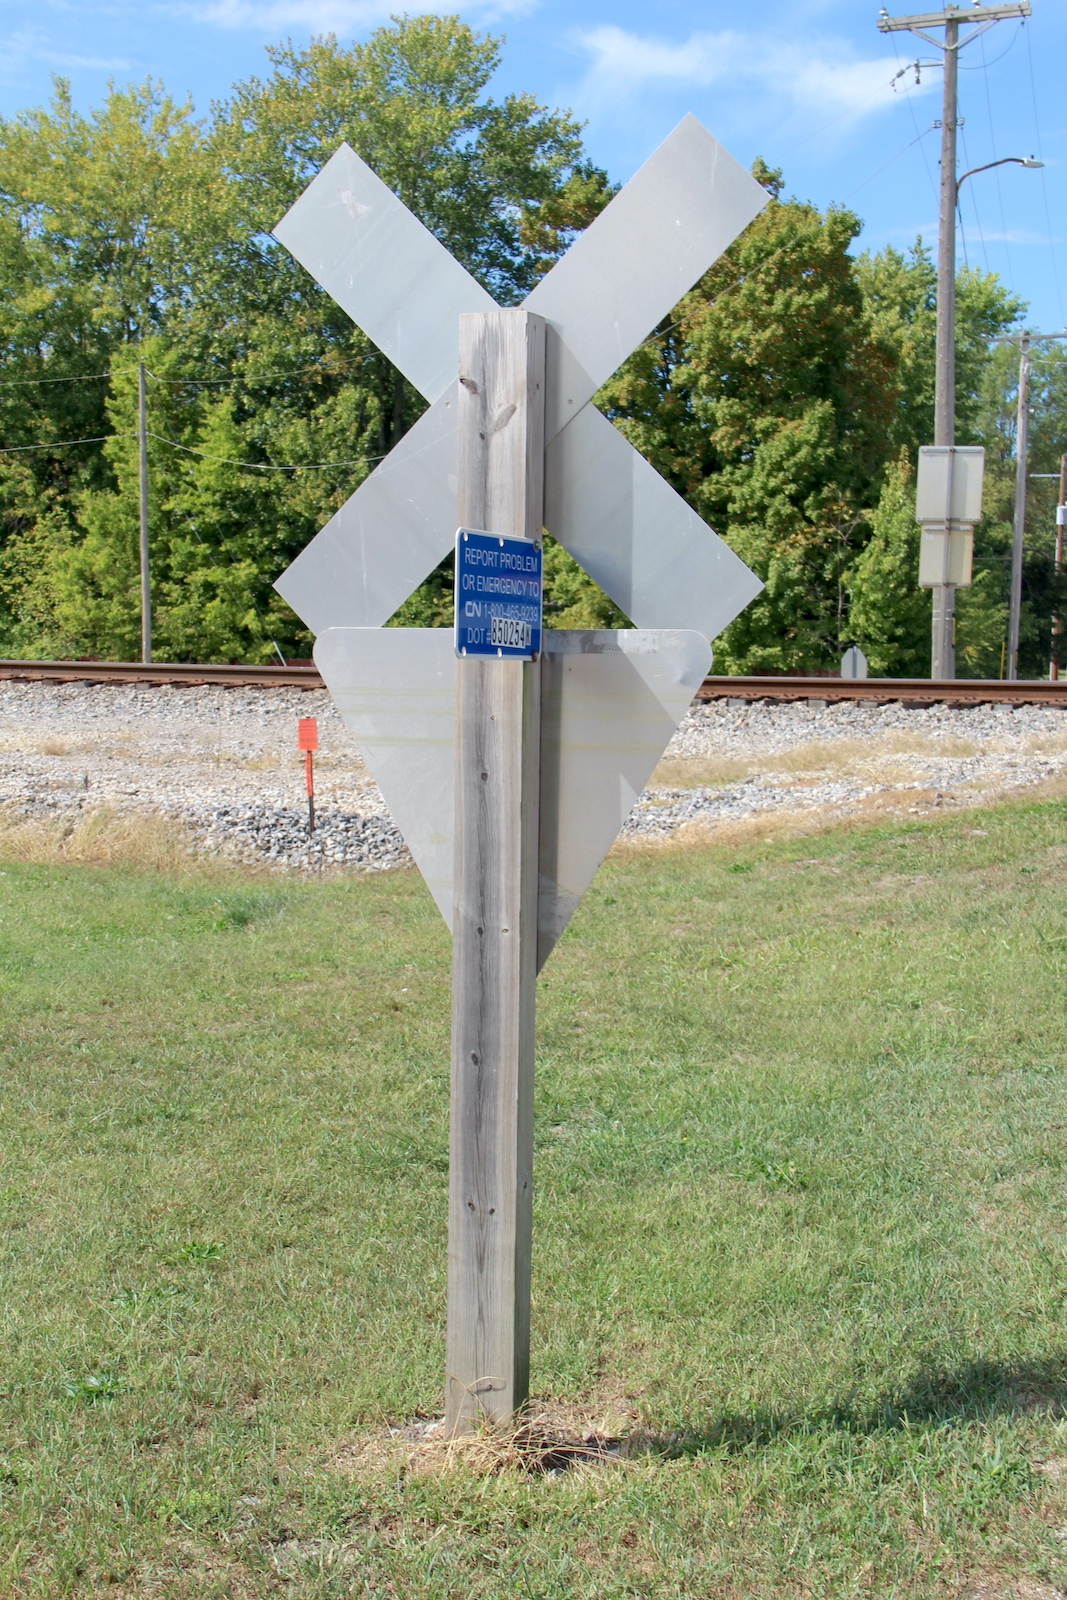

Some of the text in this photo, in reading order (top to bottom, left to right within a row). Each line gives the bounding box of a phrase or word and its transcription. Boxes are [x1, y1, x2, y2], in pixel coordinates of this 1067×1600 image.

[465, 547, 537, 572] REPORT PROBLEM
[462, 574, 539, 597] OR EMERGENCY TO
[465, 601, 538, 621] CN 1-800-465-9239
[467, 628, 485, 643] DOT
